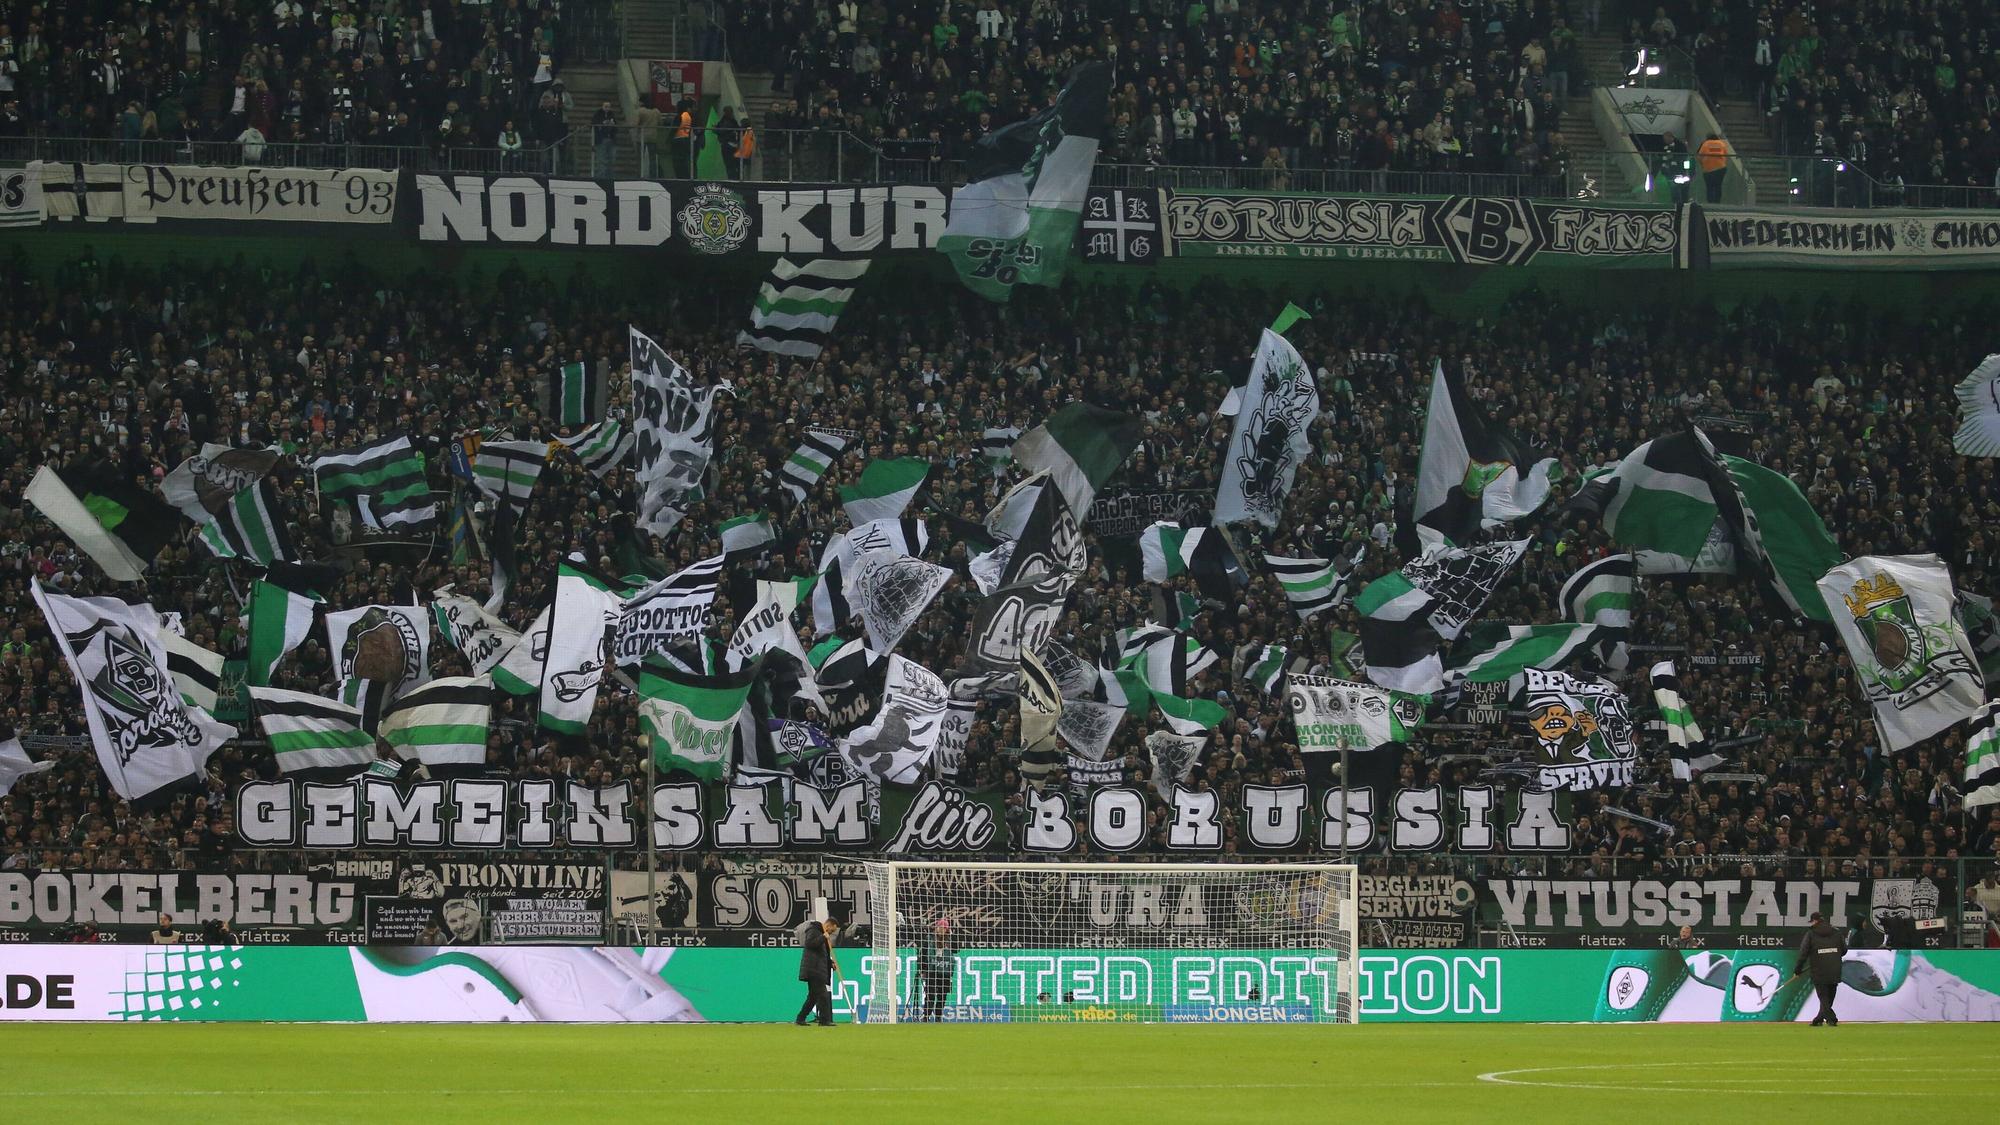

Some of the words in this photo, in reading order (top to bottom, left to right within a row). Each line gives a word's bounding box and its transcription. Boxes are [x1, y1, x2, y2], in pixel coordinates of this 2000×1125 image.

[127, 166, 320, 214] Preußen
[416, 174, 672, 246] NORD
[757, 186, 948, 253] KUR
[1089, 196, 1110, 218] A
[1168, 197, 1426, 247] BORUSSIA
[1466, 200, 1514, 260] B
[1549, 209, 1677, 256] FANS
[1087, 232, 1117, 257] M
[1709, 218, 1897, 252] NIEDERRHEIN
[1932, 221, 2000, 249] CHAO
[1215, 246, 1288, 256] IMMER
[1299, 247, 1337, 257] UND
[1346, 247, 1443, 260] ÜBERALL!
[1691, 656, 1716, 665] NORD
[1728, 655, 1761, 665] KURVE
[1464, 681, 1507, 693] SALARY
[1474, 692, 1496, 705] CAP
[1467, 709, 1503, 724] NOW!
[1296, 721, 1364, 736] MÖNCHEN
[1299, 735, 1368, 747] GLADACH
[238, 778, 873, 852] GEMEINSAM
[882, 781, 998, 853] für
[1023, 783, 1572, 853] BORUSSIA
[336, 860, 393, 876] BANDA
[440, 863, 604, 889] FRONTLINE
[0, 867, 354, 925] BÖKELBERG
[541, 889, 563, 899] seit
[569, 889, 602, 899] 2006
[1358, 874, 1454, 896] BEGLEIT
[377, 906, 395, 916] Egal
[409, 906, 420, 914] wir
[508, 899, 534, 910] WIR
[536, 899, 586, 910] WOLLEN
[1070, 878, 1209, 928] URA
[1358, 895, 1452, 918] SERVICE
[1488, 878, 1860, 927] VITUSSTADT
[240, 929, 290, 942] flatex
[326, 929, 365, 942] flat
[748, 933, 800, 946] flate
[493, 925, 518, 936] ALS
[519, 925, 602, 936] DISKUTIEREN
[1166, 933, 1230, 948] flatex
[1579, 934, 1626, 946] flatex
[1737, 934, 1784, 946] flatex
[1172, 955, 1501, 1014] EDITION
